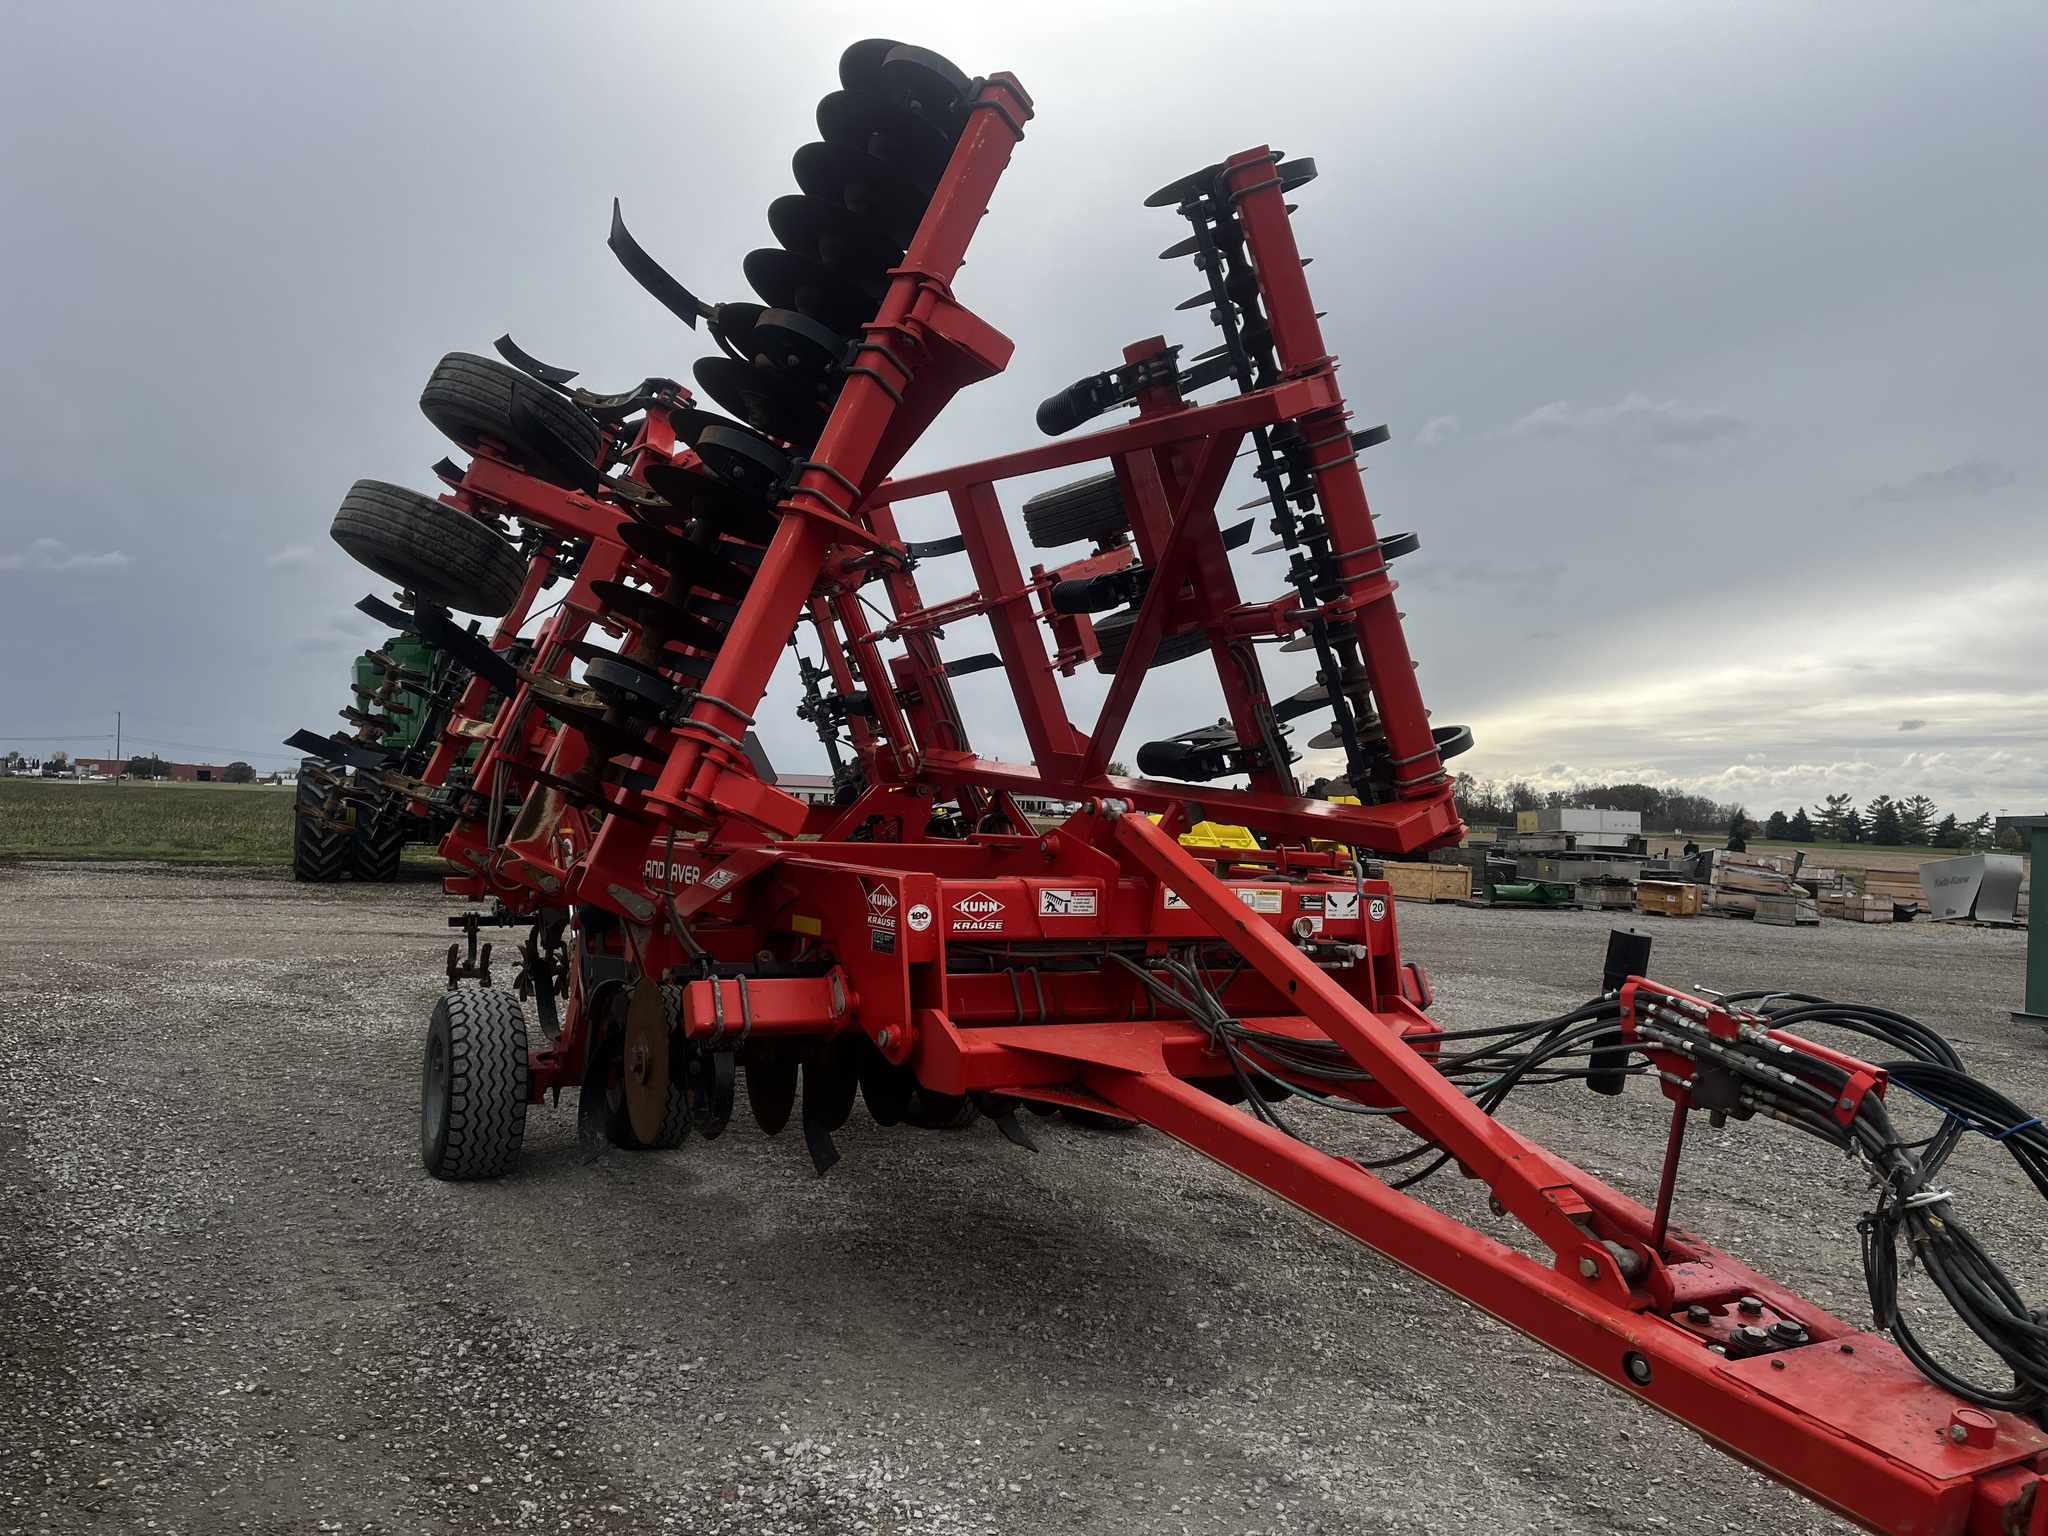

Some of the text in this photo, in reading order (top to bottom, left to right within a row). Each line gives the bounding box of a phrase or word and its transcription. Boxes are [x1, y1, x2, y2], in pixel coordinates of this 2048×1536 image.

[871, 893, 893, 907] KUHN
[960, 901, 998, 913] KUHN
[1372, 903, 1383, 913] 20
[867, 915, 896, 928] KRAUSE
[952, 922, 1004, 930] KRAUSE
